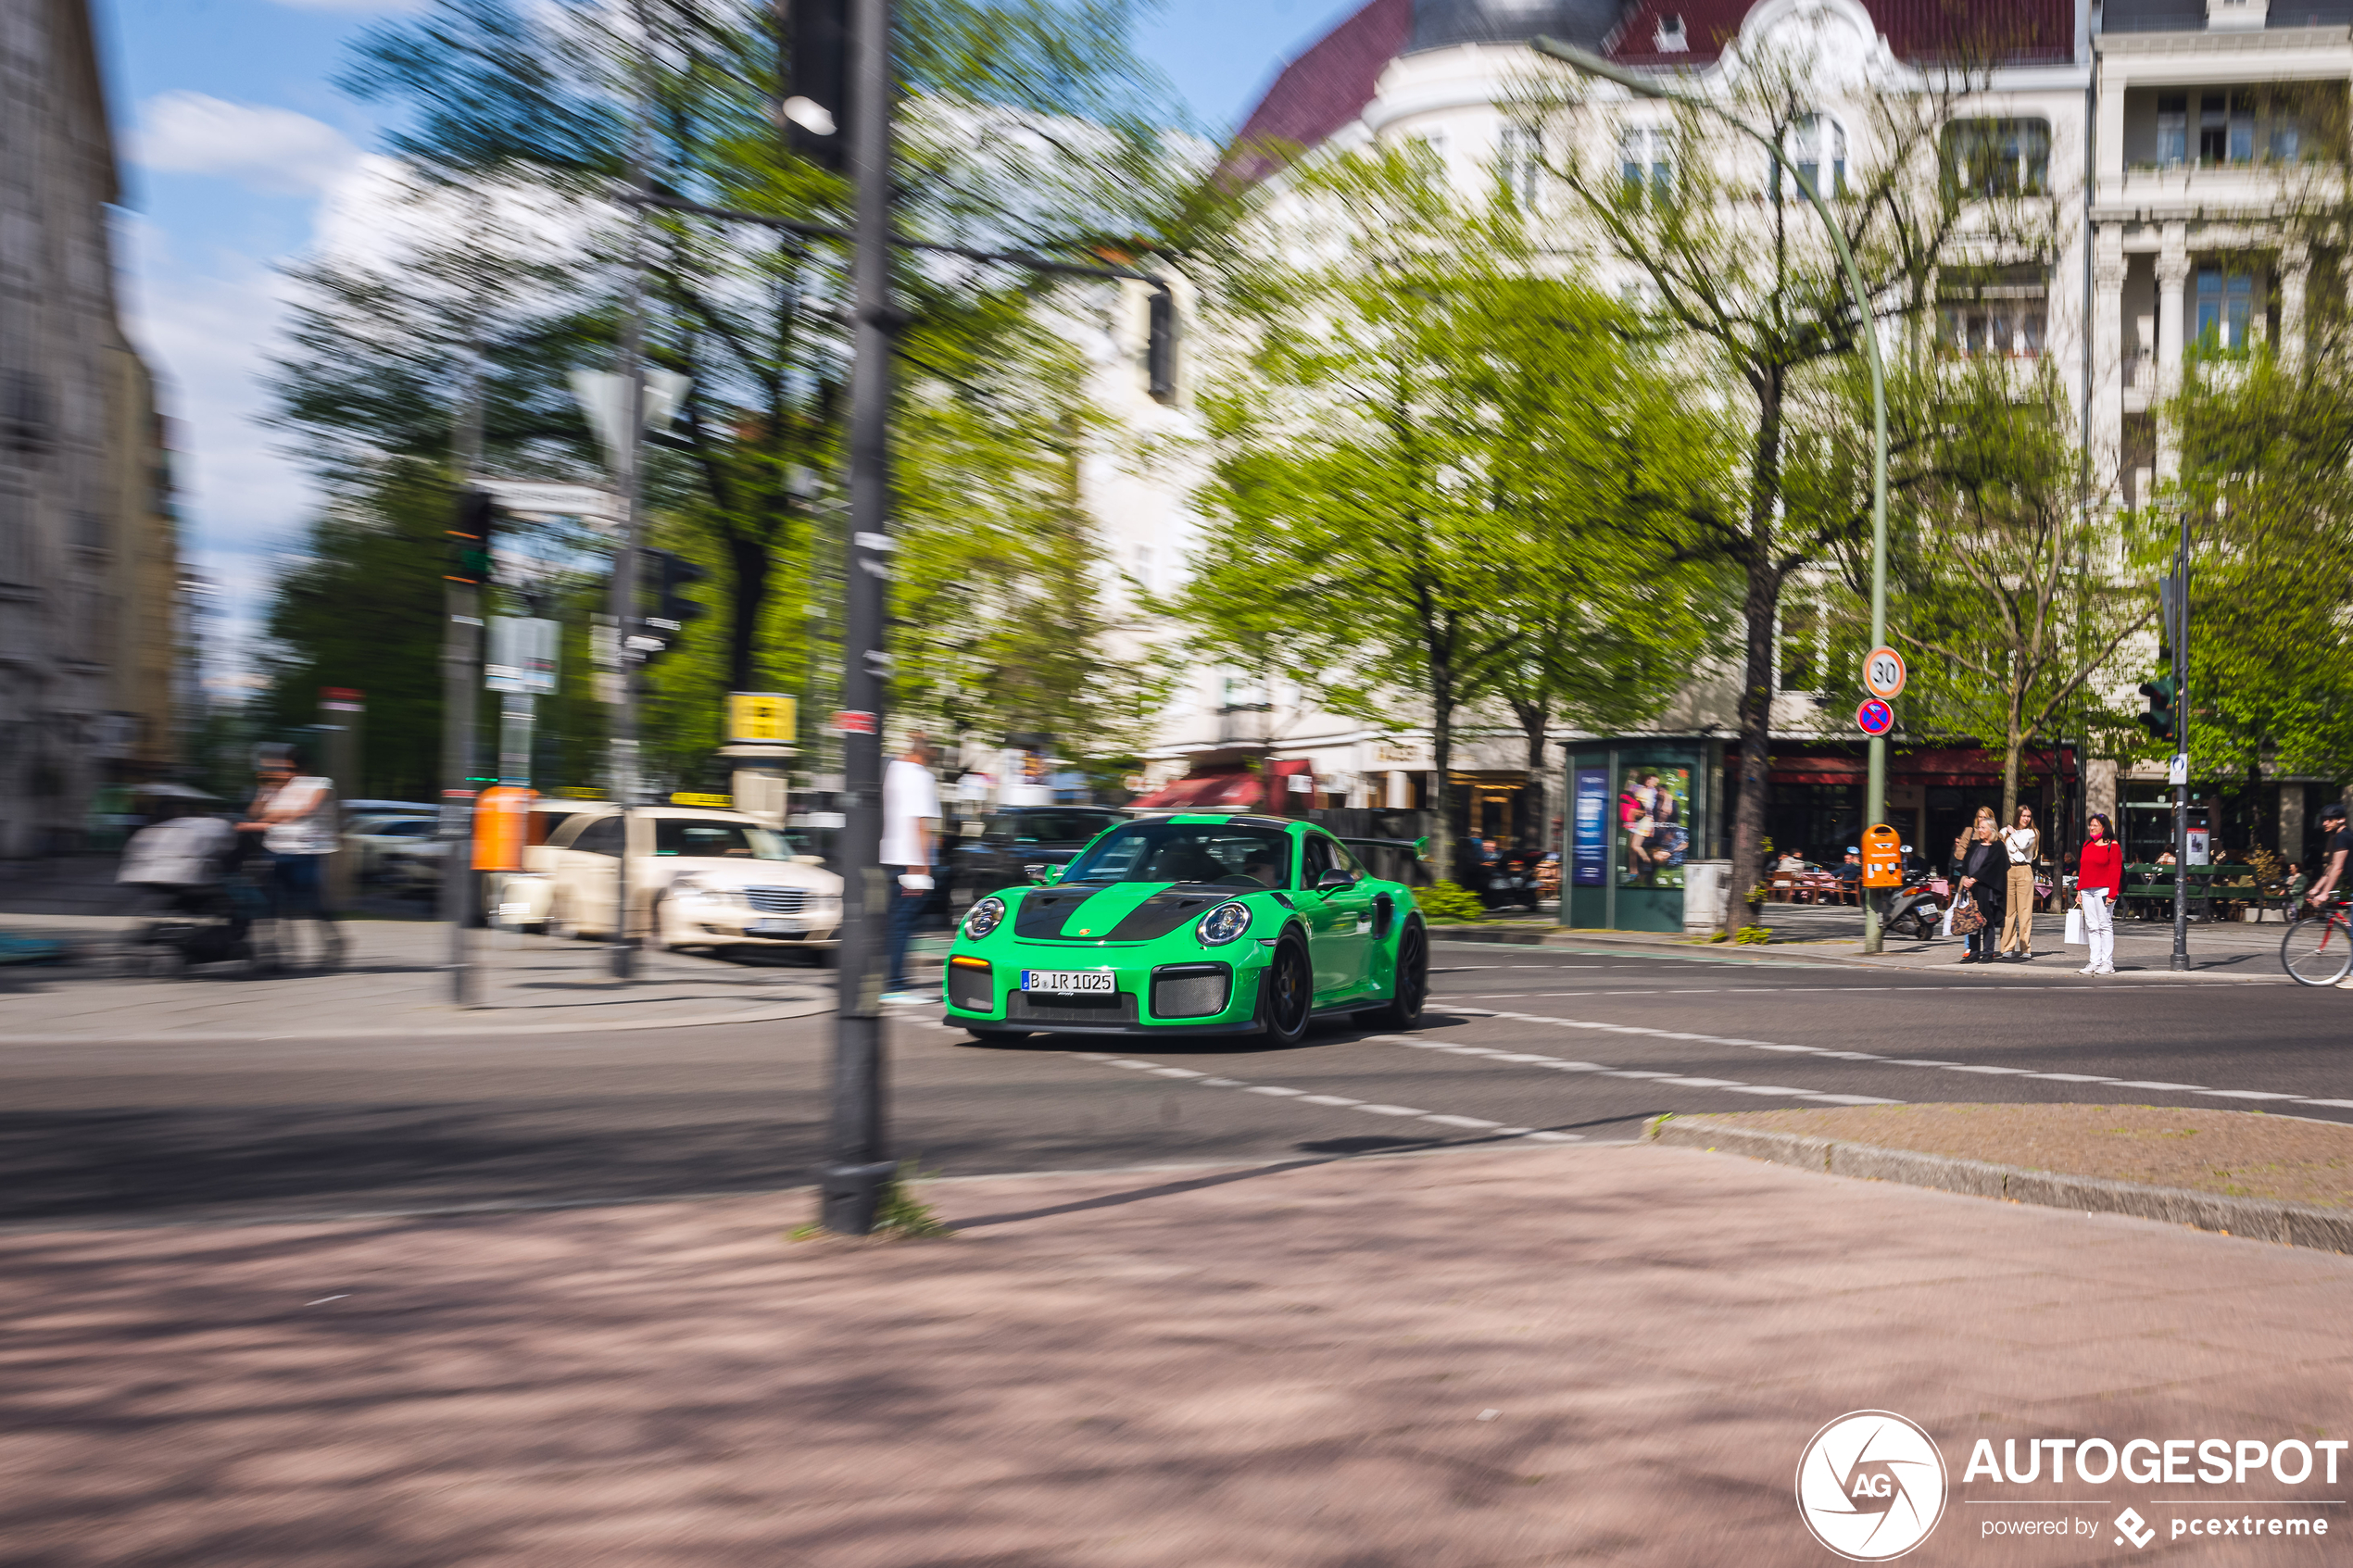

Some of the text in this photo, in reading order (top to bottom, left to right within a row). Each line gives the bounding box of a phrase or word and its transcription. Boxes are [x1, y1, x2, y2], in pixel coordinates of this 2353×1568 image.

[1872, 661, 1896, 684] 30
[1031, 973, 1039, 988] B
[1051, 973, 1069, 989] IR
[1073, 974, 1111, 990] 1025
